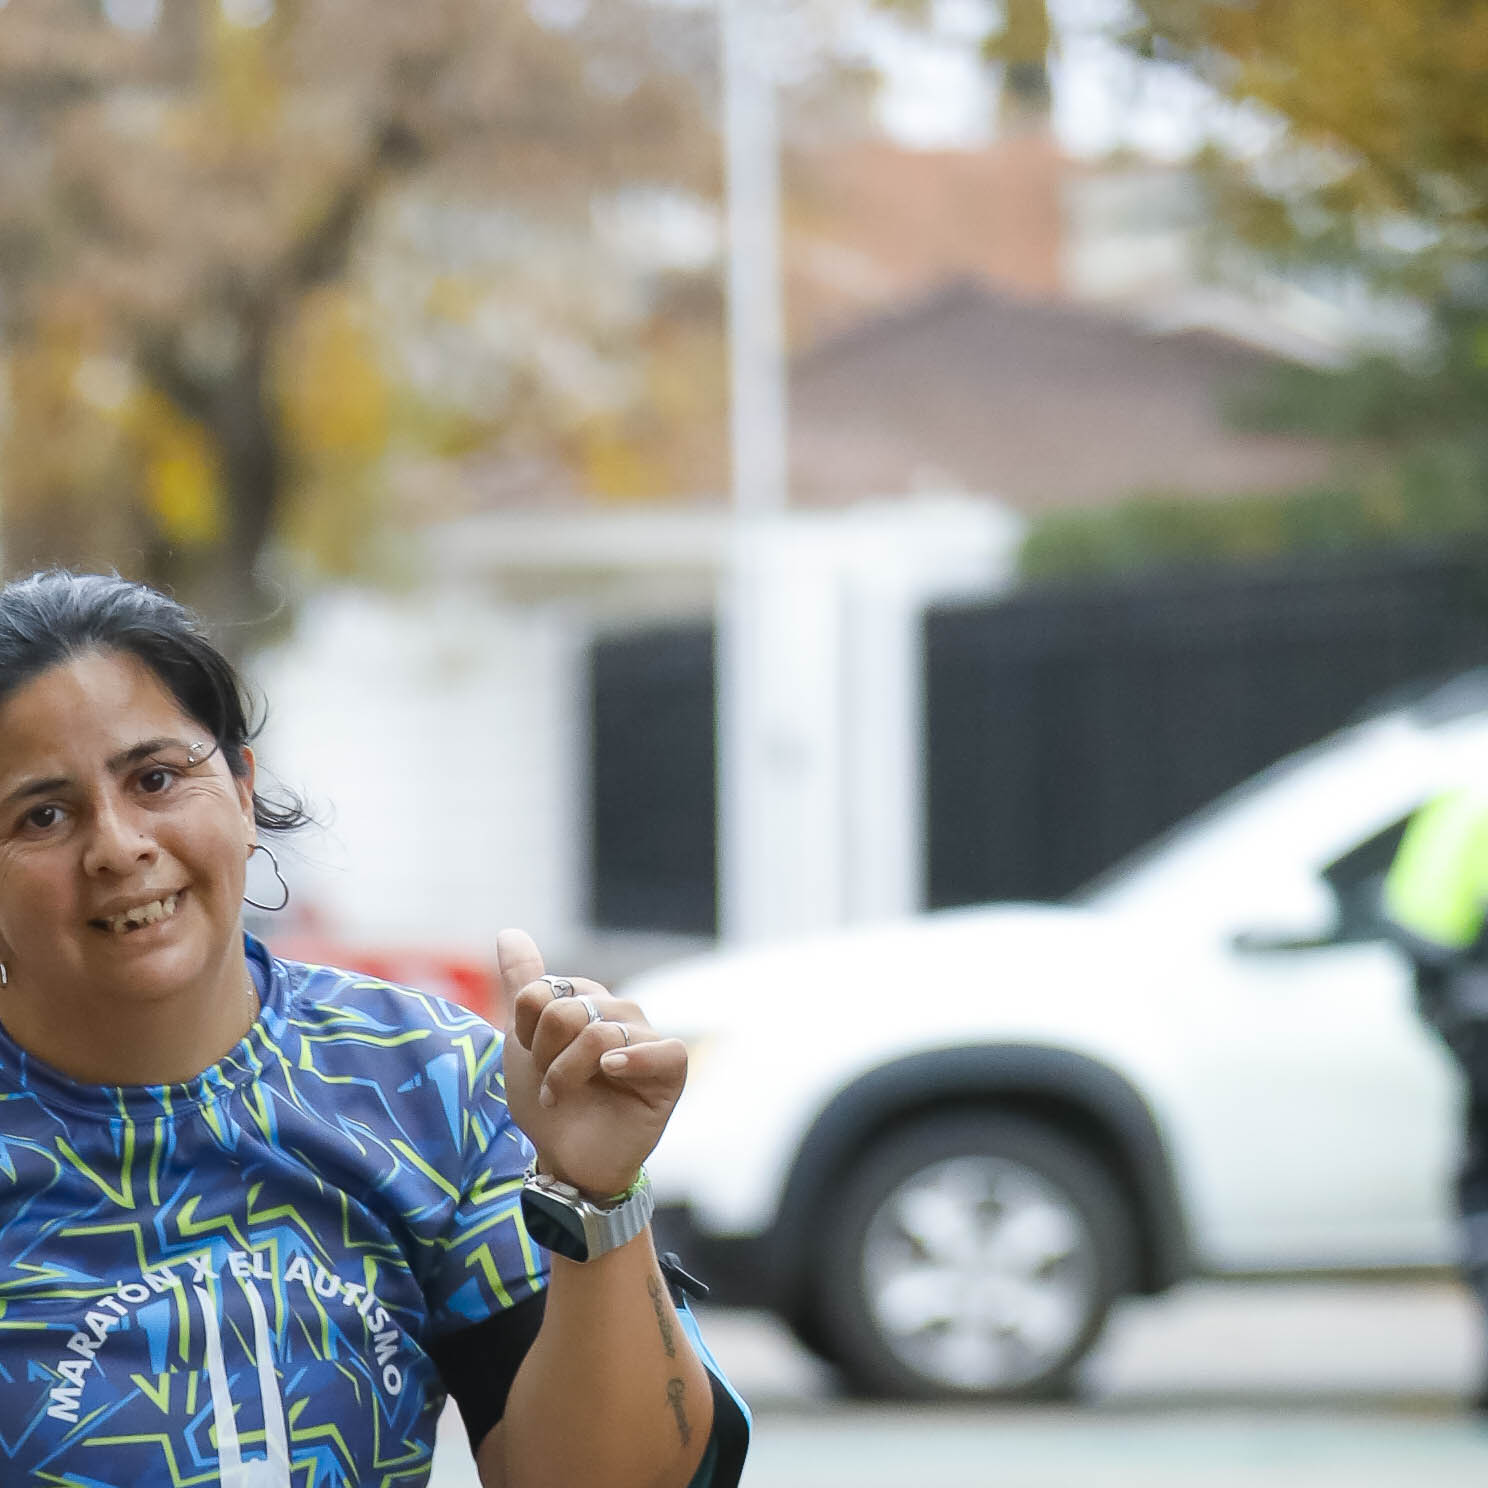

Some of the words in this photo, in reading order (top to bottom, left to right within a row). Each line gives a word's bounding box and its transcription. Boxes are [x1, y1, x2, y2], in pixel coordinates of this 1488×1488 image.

[47, 1265, 181, 1424] MARATÓN
[186, 1254, 220, 1283] X
[227, 1251, 273, 1280] EL
[283, 1256, 403, 1397] AUTISMO
